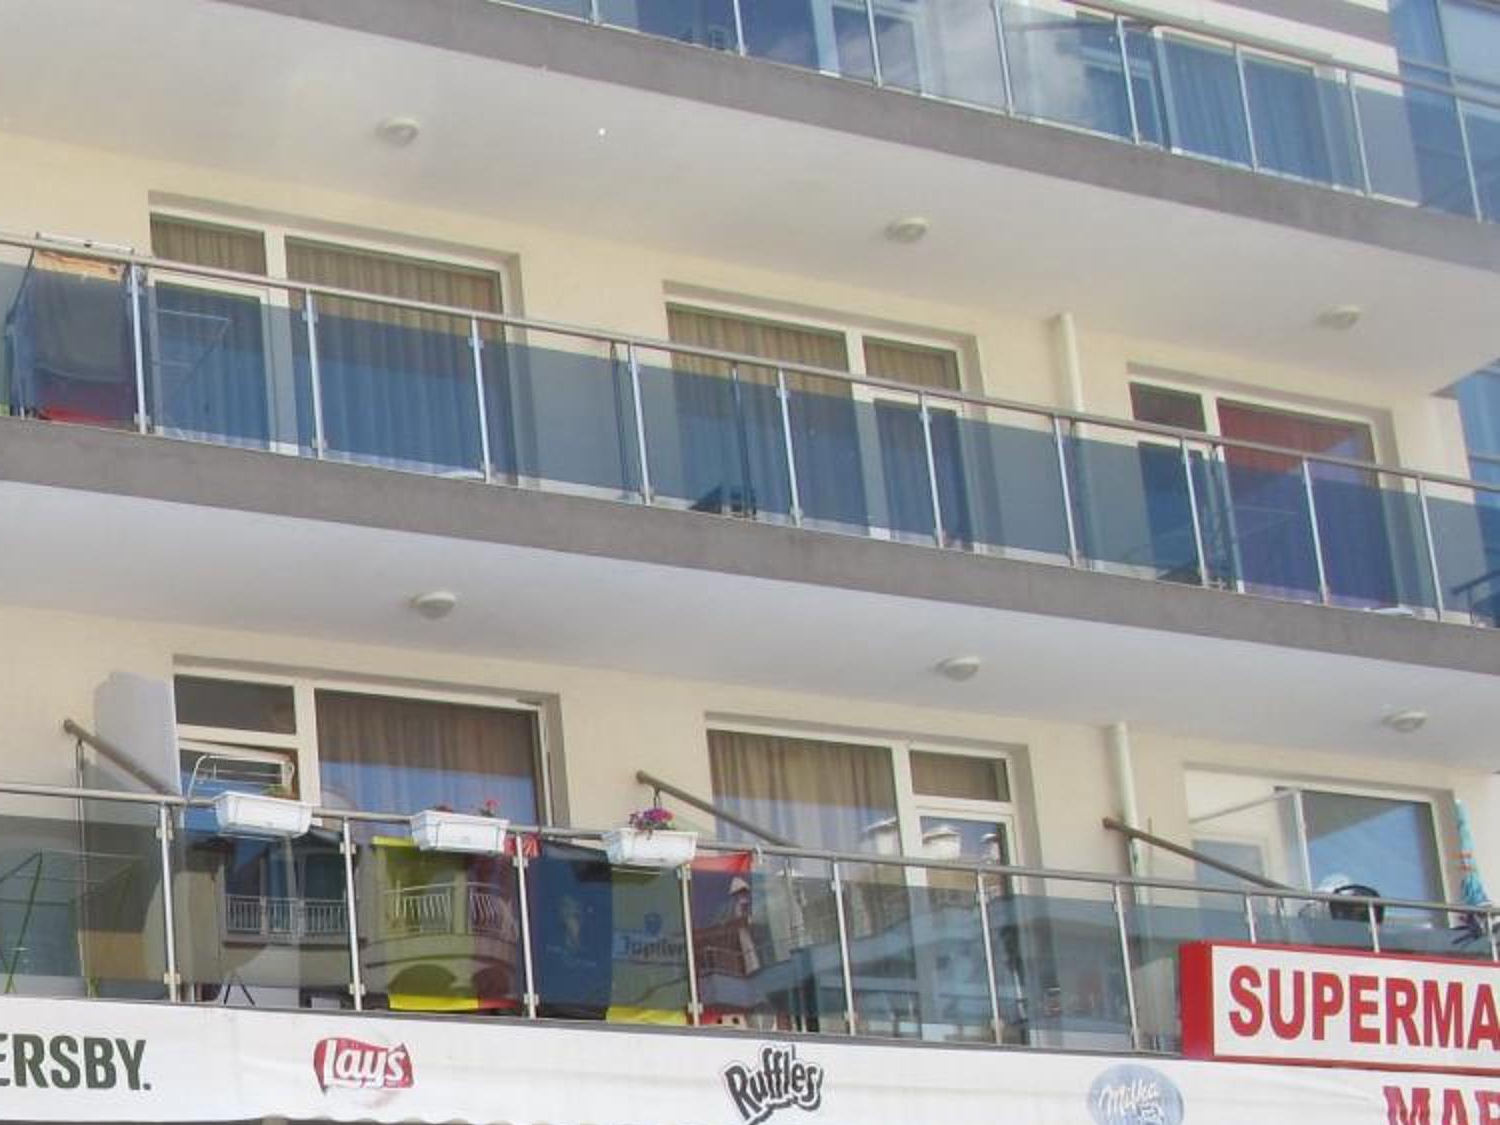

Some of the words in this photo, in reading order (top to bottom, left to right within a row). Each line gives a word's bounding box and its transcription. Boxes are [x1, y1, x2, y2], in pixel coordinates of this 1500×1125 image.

[1228, 964, 1500, 1052] SUPERMA
[724, 1046, 819, 1122] Ruffles
[1097, 1078, 1160, 1118] Milka
